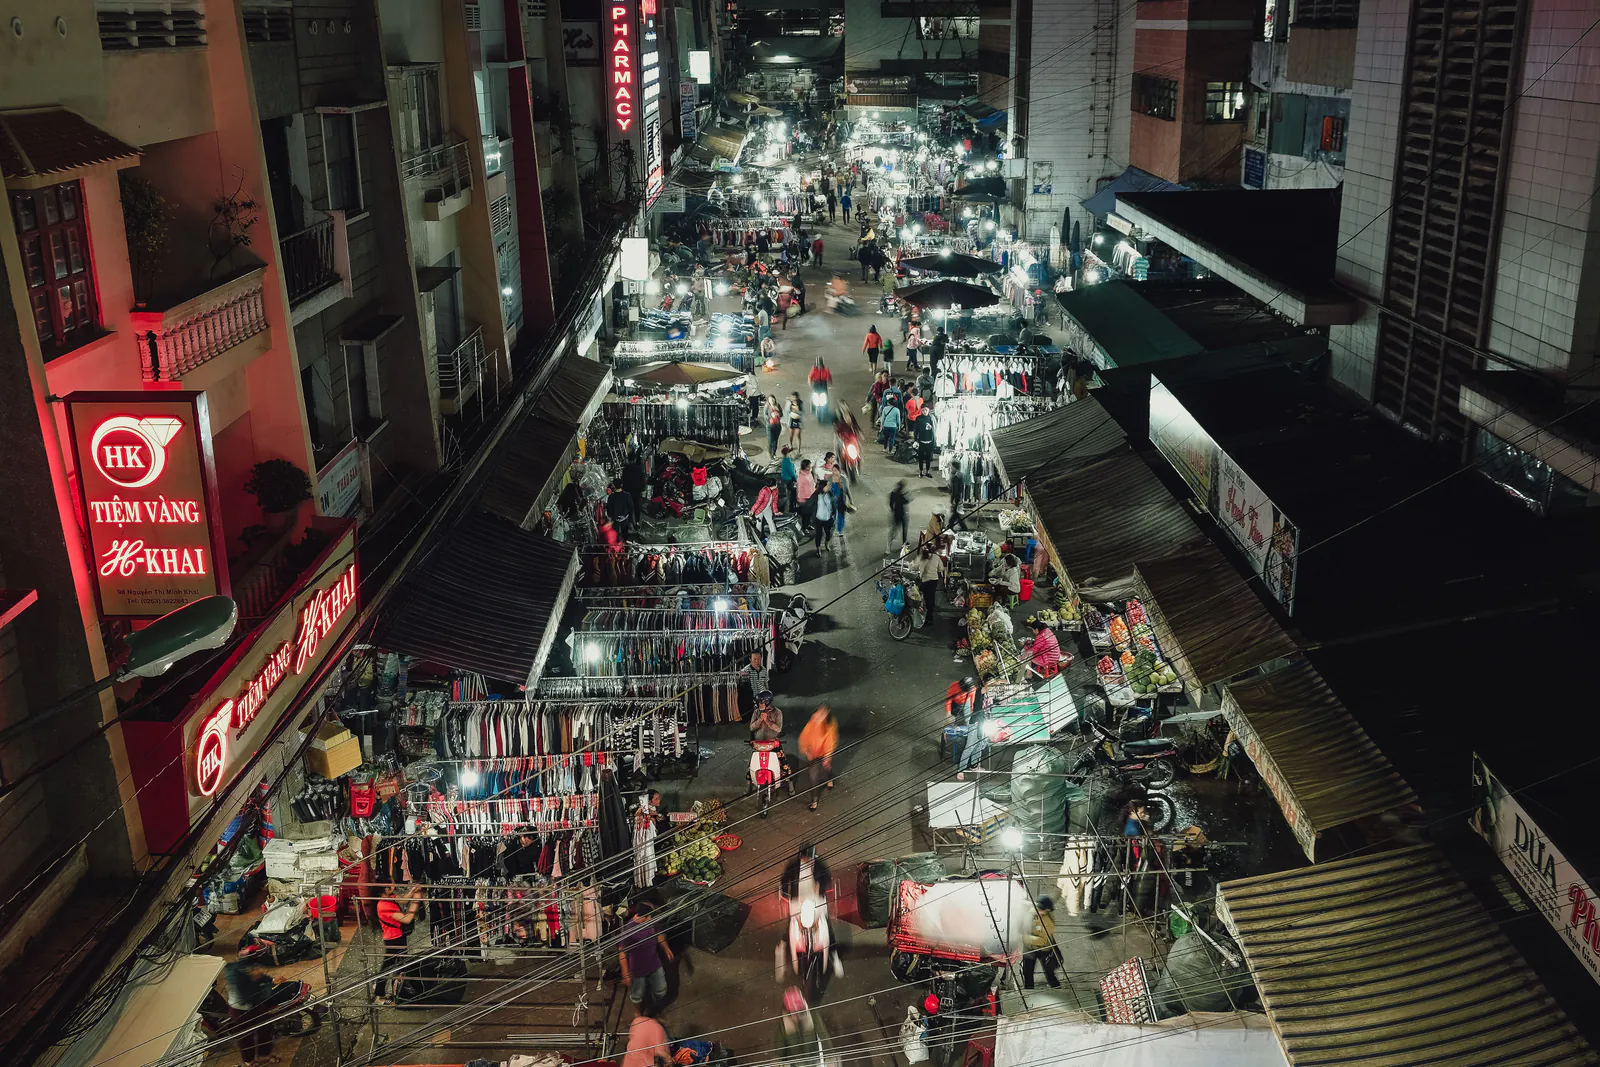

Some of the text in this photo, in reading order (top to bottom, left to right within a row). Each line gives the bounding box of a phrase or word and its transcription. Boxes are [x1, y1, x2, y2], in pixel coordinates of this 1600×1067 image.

[612, 7, 631, 131] PHARMACY
[104, 446, 145, 468] HK
[90, 494, 200, 528] TIỆM VÀNG
[101, 540, 206, 577] H-KHAI
[296, 564, 356, 674] H-KHAI
[237, 680, 264, 728] TIỆM
[263, 643, 291, 691] VÀNG
[200, 743, 219, 784] HK
